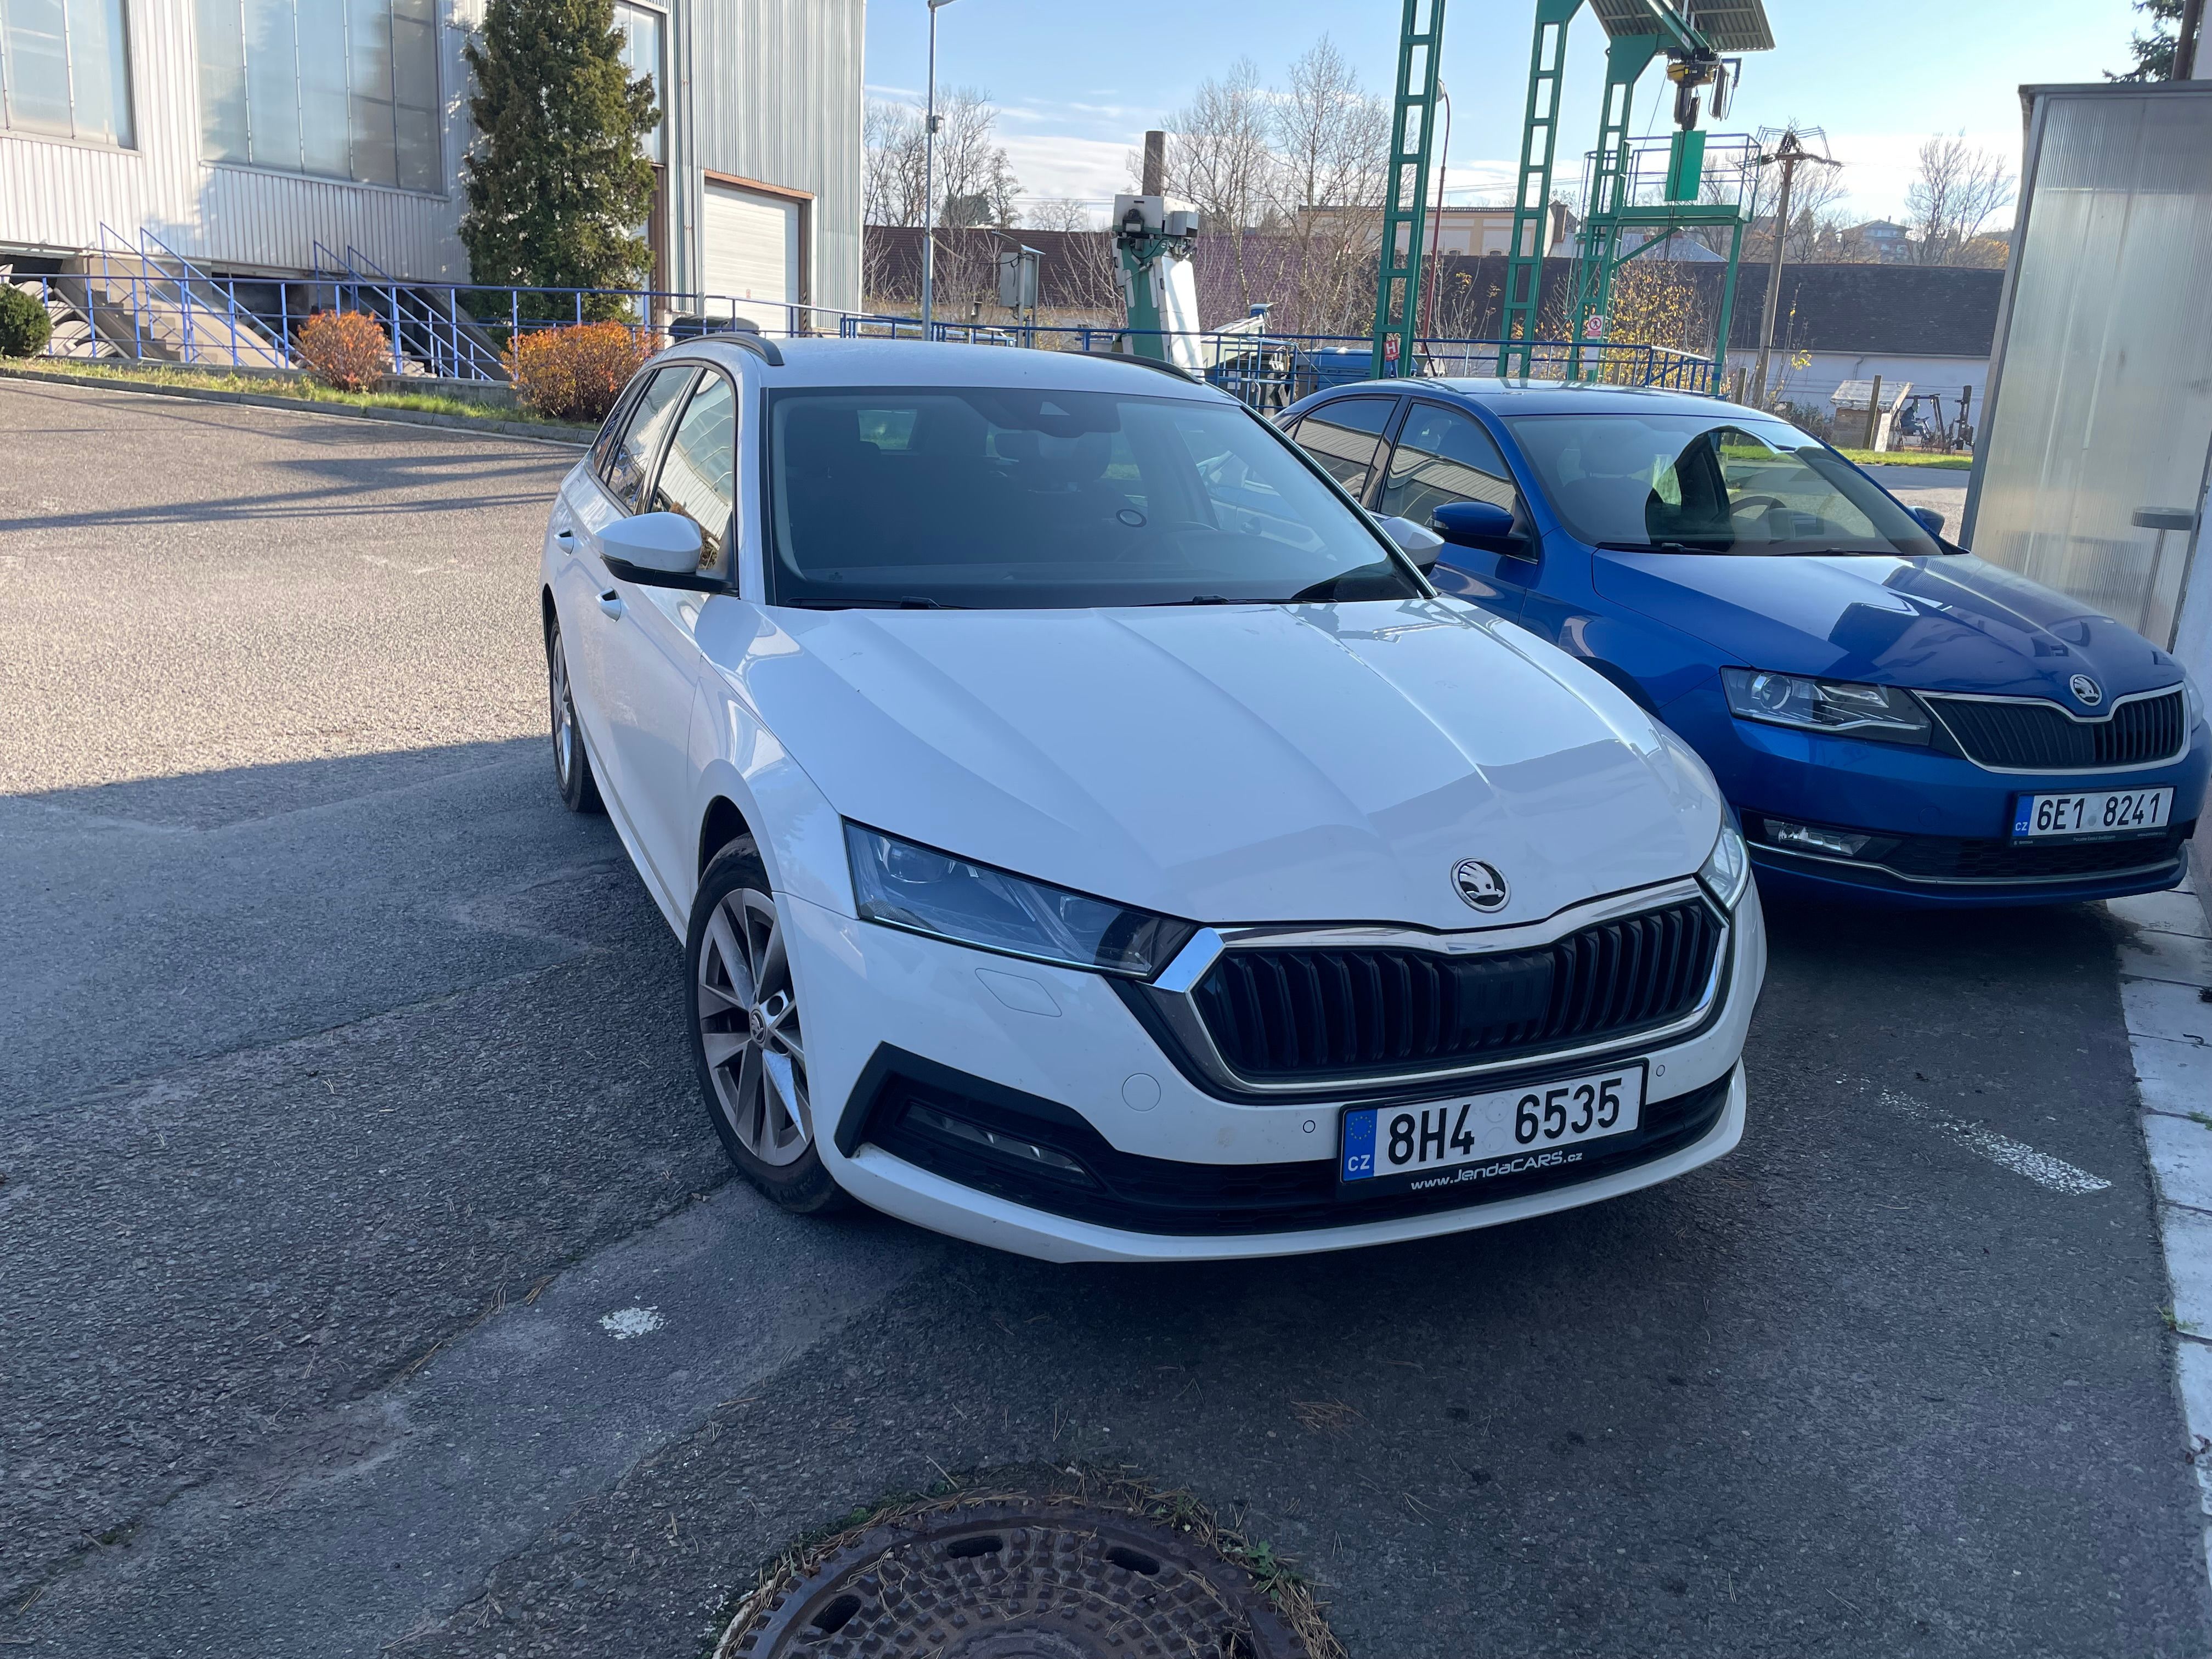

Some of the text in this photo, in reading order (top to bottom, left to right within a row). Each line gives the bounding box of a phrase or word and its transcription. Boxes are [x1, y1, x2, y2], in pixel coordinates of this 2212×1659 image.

[1386, 341, 1396, 354] H
[2036, 793, 2160, 830] 6E1 8241
[2015, 821, 2028, 831] CZ
[1388, 1077, 1622, 1165] 8H4 6535
[1348, 1154, 1370, 1172] CZ
[1411, 1150, 1583, 1190] www.JendaCARS.cz
